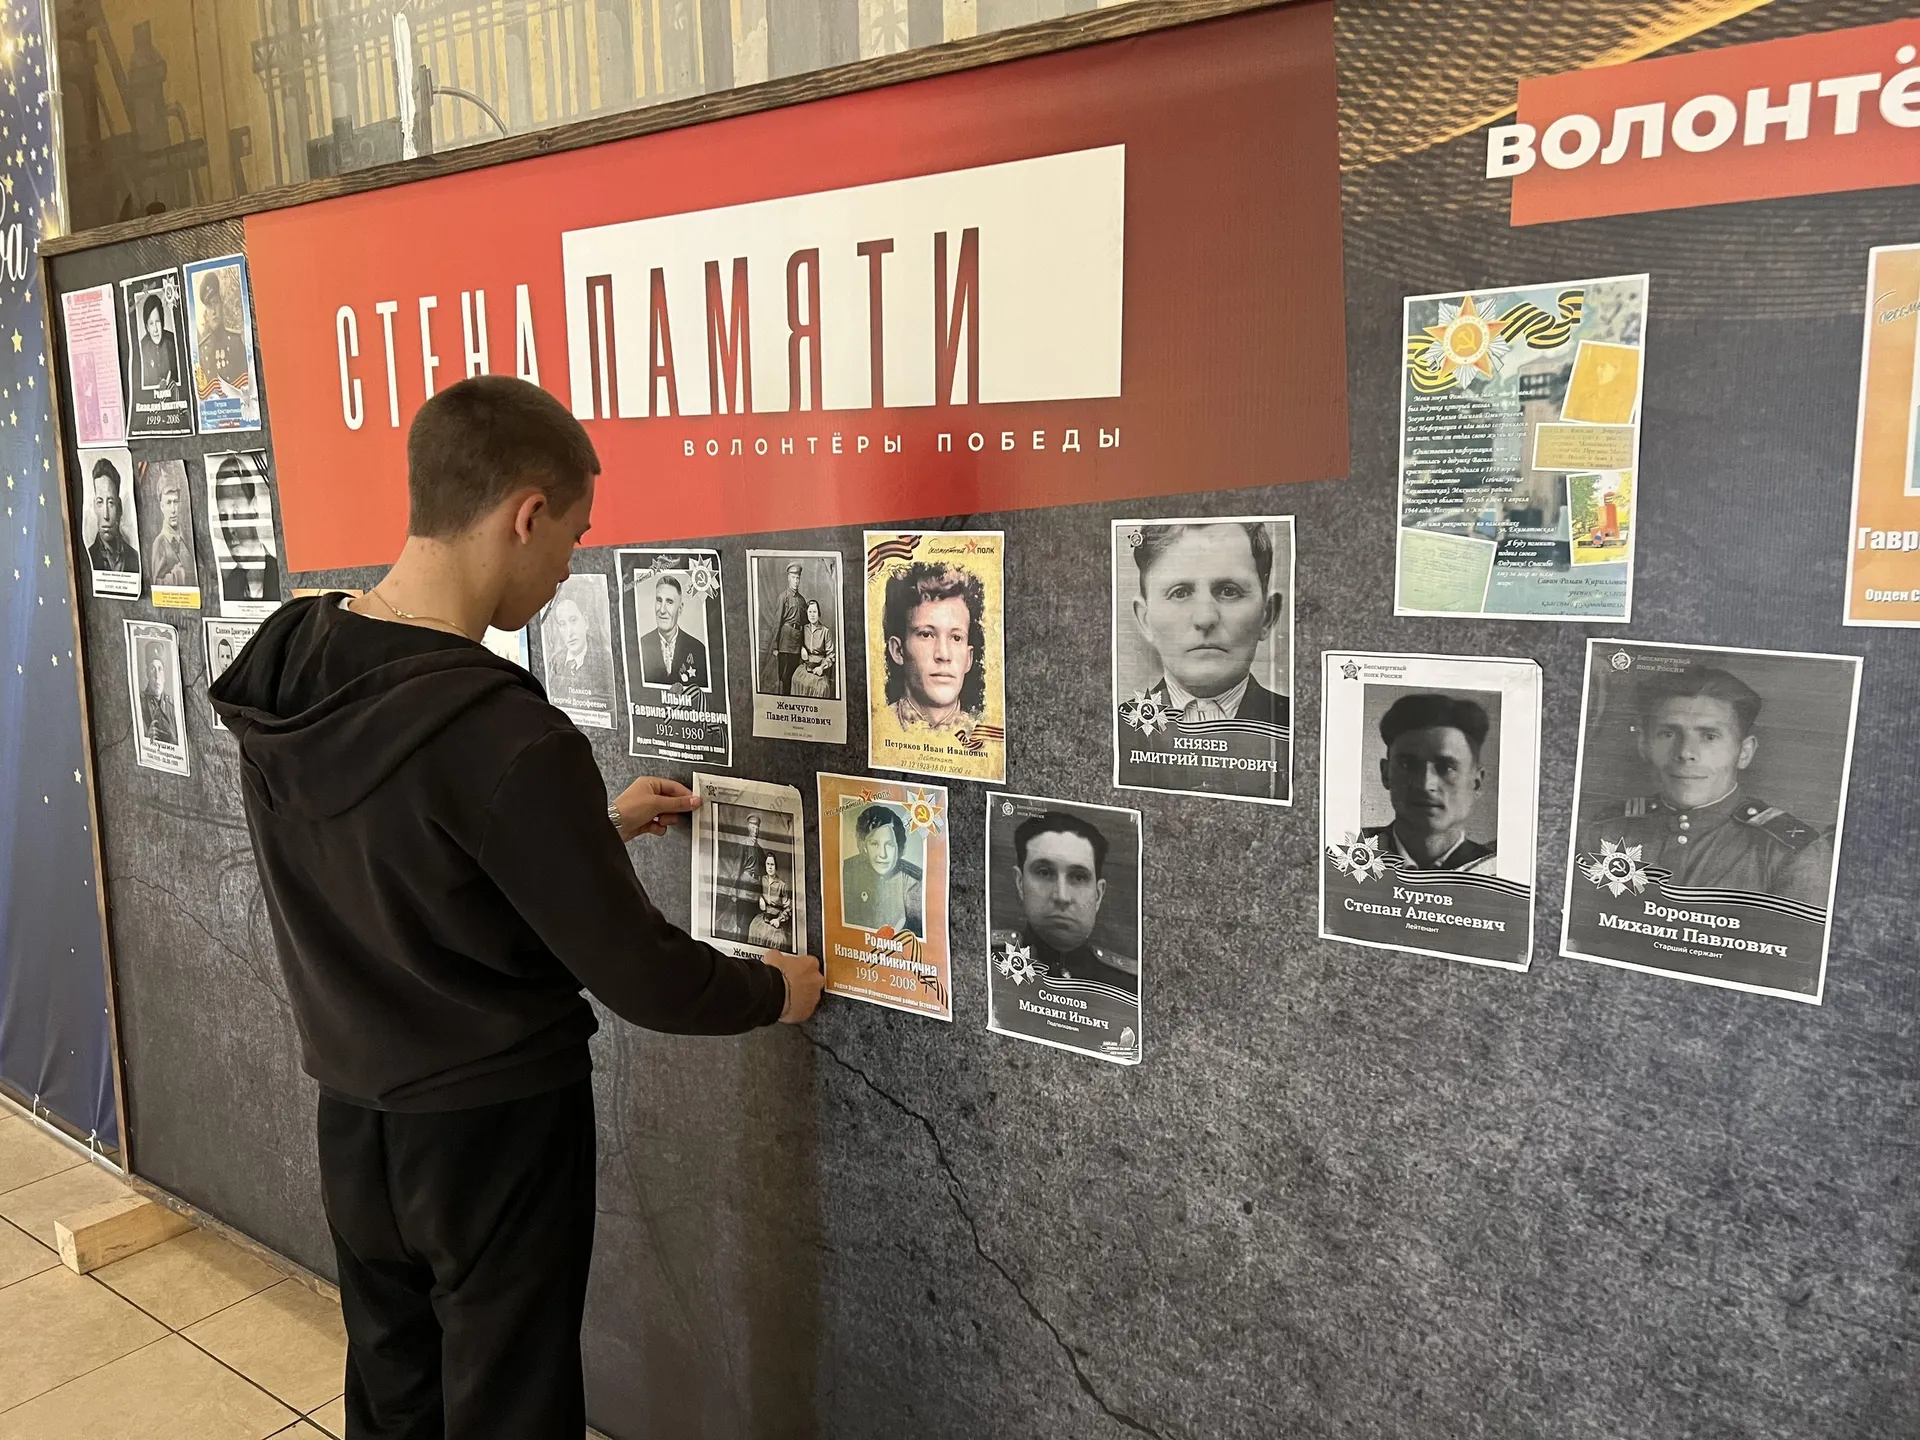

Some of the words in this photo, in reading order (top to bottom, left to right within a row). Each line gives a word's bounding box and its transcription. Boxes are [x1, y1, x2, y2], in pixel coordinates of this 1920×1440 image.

[336, 284, 541, 431] СТЕНА
[585, 226, 980, 420] ПАМЯТИ
[683, 434, 902, 458] ВОЛОНТЁРЫ
[937, 427, 1122, 453] ПОБЕДЫ
[1858, 527, 1920, 552] Гавр
[1865, 588, 1909, 602] Орден
[1363, 663, 1407, 672] Бессмертный
[661, 690, 692, 706] Ильин
[777, 701, 818, 713] Жемчугов
[630, 702, 665, 718] Гаврила
[665, 707, 728, 724] Тимофеевич
[766, 712, 789, 721] Павел
[791, 714, 831, 725] Иванович
[656, 724, 673, 736] 1912
[682, 727, 704, 740] 1980
[885, 739, 921, 751] Петряков
[923, 743, 944, 753] Иван
[947, 746, 989, 758] Иванович
[1173, 737, 1228, 752] КНЯЗЕВ
[1130, 750, 1199, 767] ДМИТРИЙ
[1201, 755, 1278, 773] ПЕТРОВИЧ
[1392, 885, 1453, 906] Куртов
[1344, 897, 1402, 918] Степан
[1405, 907, 1506, 932] Алексеевич
[1643, 901, 1741, 930] Воронцов
[1405, 922, 1440, 934] Лейтенант
[1598, 912, 1678, 940] Михаил
[1682, 927, 1788, 957] Павлович
[865, 933, 903, 952] Родина
[1653, 941, 1688, 955] Старший
[1689, 946, 1723, 959] сержант
[733, 947, 764, 960] Жемчу
[835, 943, 878, 964] Клавдия
[880, 953, 937, 976] Никитична
[856, 967, 878, 983] 1919
[890, 975, 916, 991] 2008
[1038, 989, 1087, 1010] Соколов
[1019, 999, 1066, 1020] Михаил
[1069, 1010, 1109, 1030] Ильич
